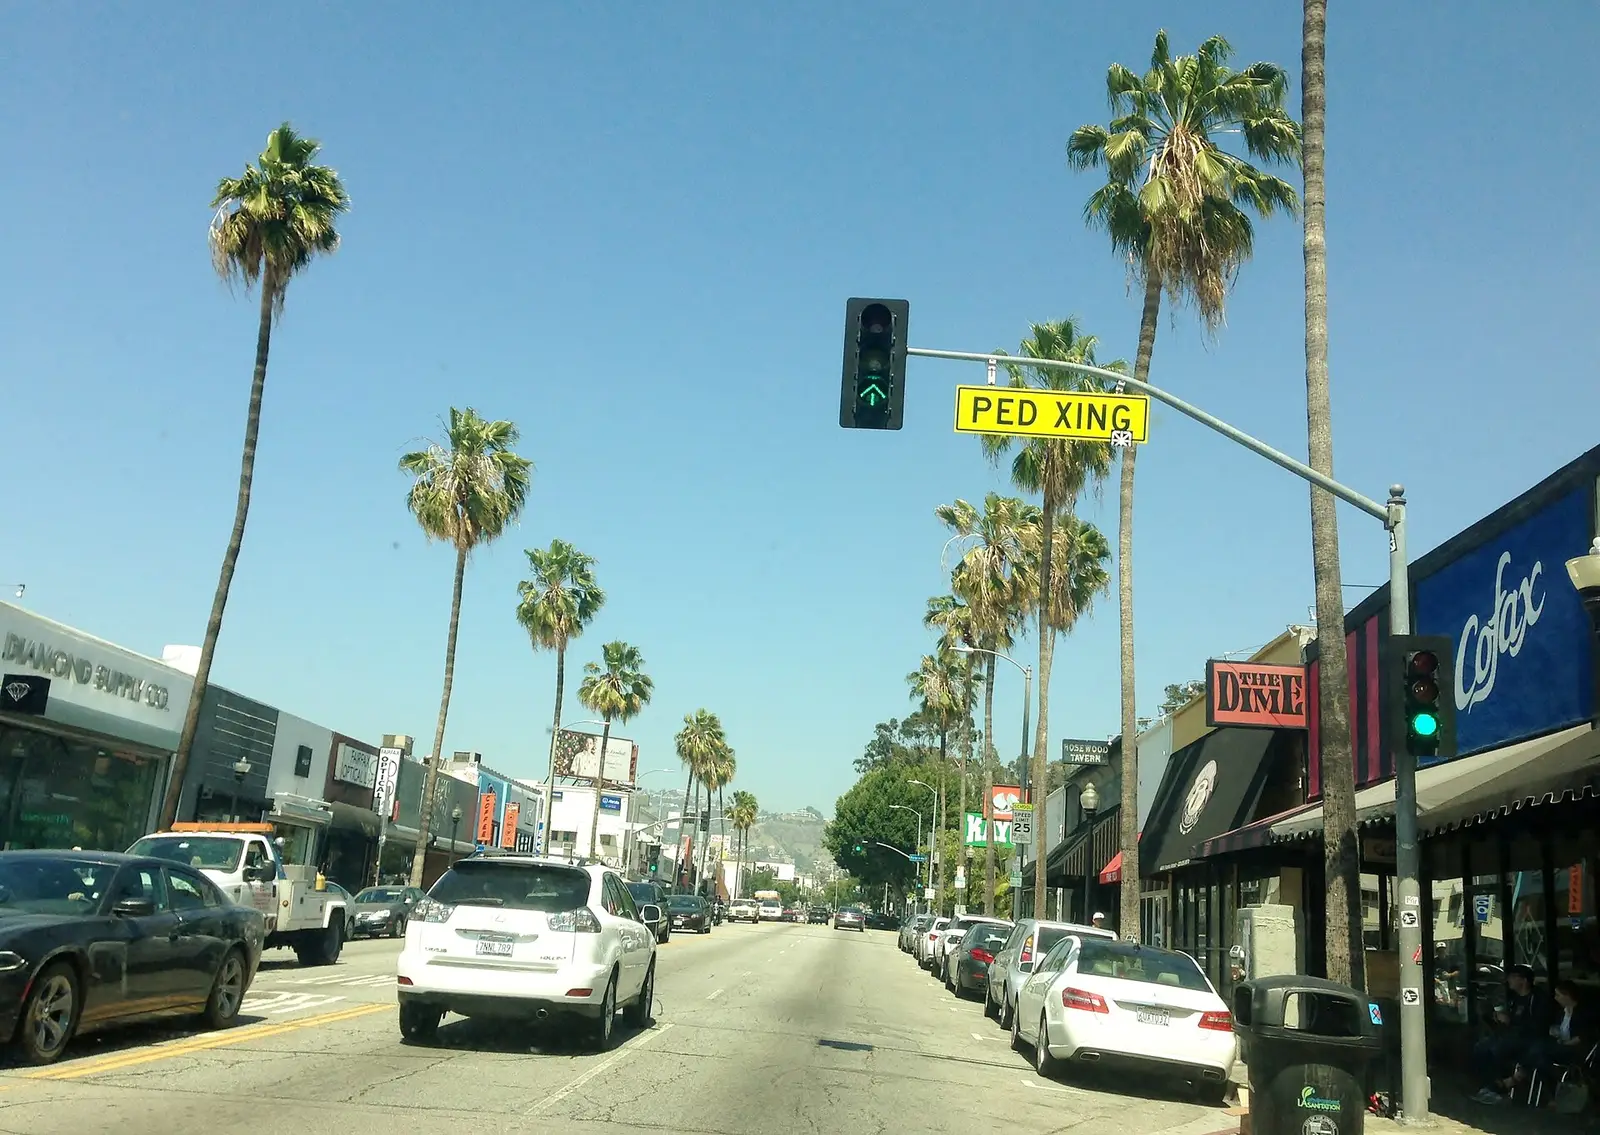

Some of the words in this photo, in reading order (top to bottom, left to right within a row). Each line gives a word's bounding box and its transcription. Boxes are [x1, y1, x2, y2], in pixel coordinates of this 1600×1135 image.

[972, 396, 1037, 426] PED
[1054, 401, 1131, 431] XING
[1454, 551, 1546, 714] Cofax
[3, 632, 93, 685] DIAMOND
[94, 664, 146, 702] SUPPLY
[1239, 672, 1281, 686] THE
[1216, 671, 1304, 715] DIME
[1070, 753, 1101, 763] TAVERN
[376, 756, 389, 800] OPTICAL
[481, 795, 491, 838] COFFEE
[966, 812, 1016, 845] KAY
[1014, 822, 1031, 833] 25
